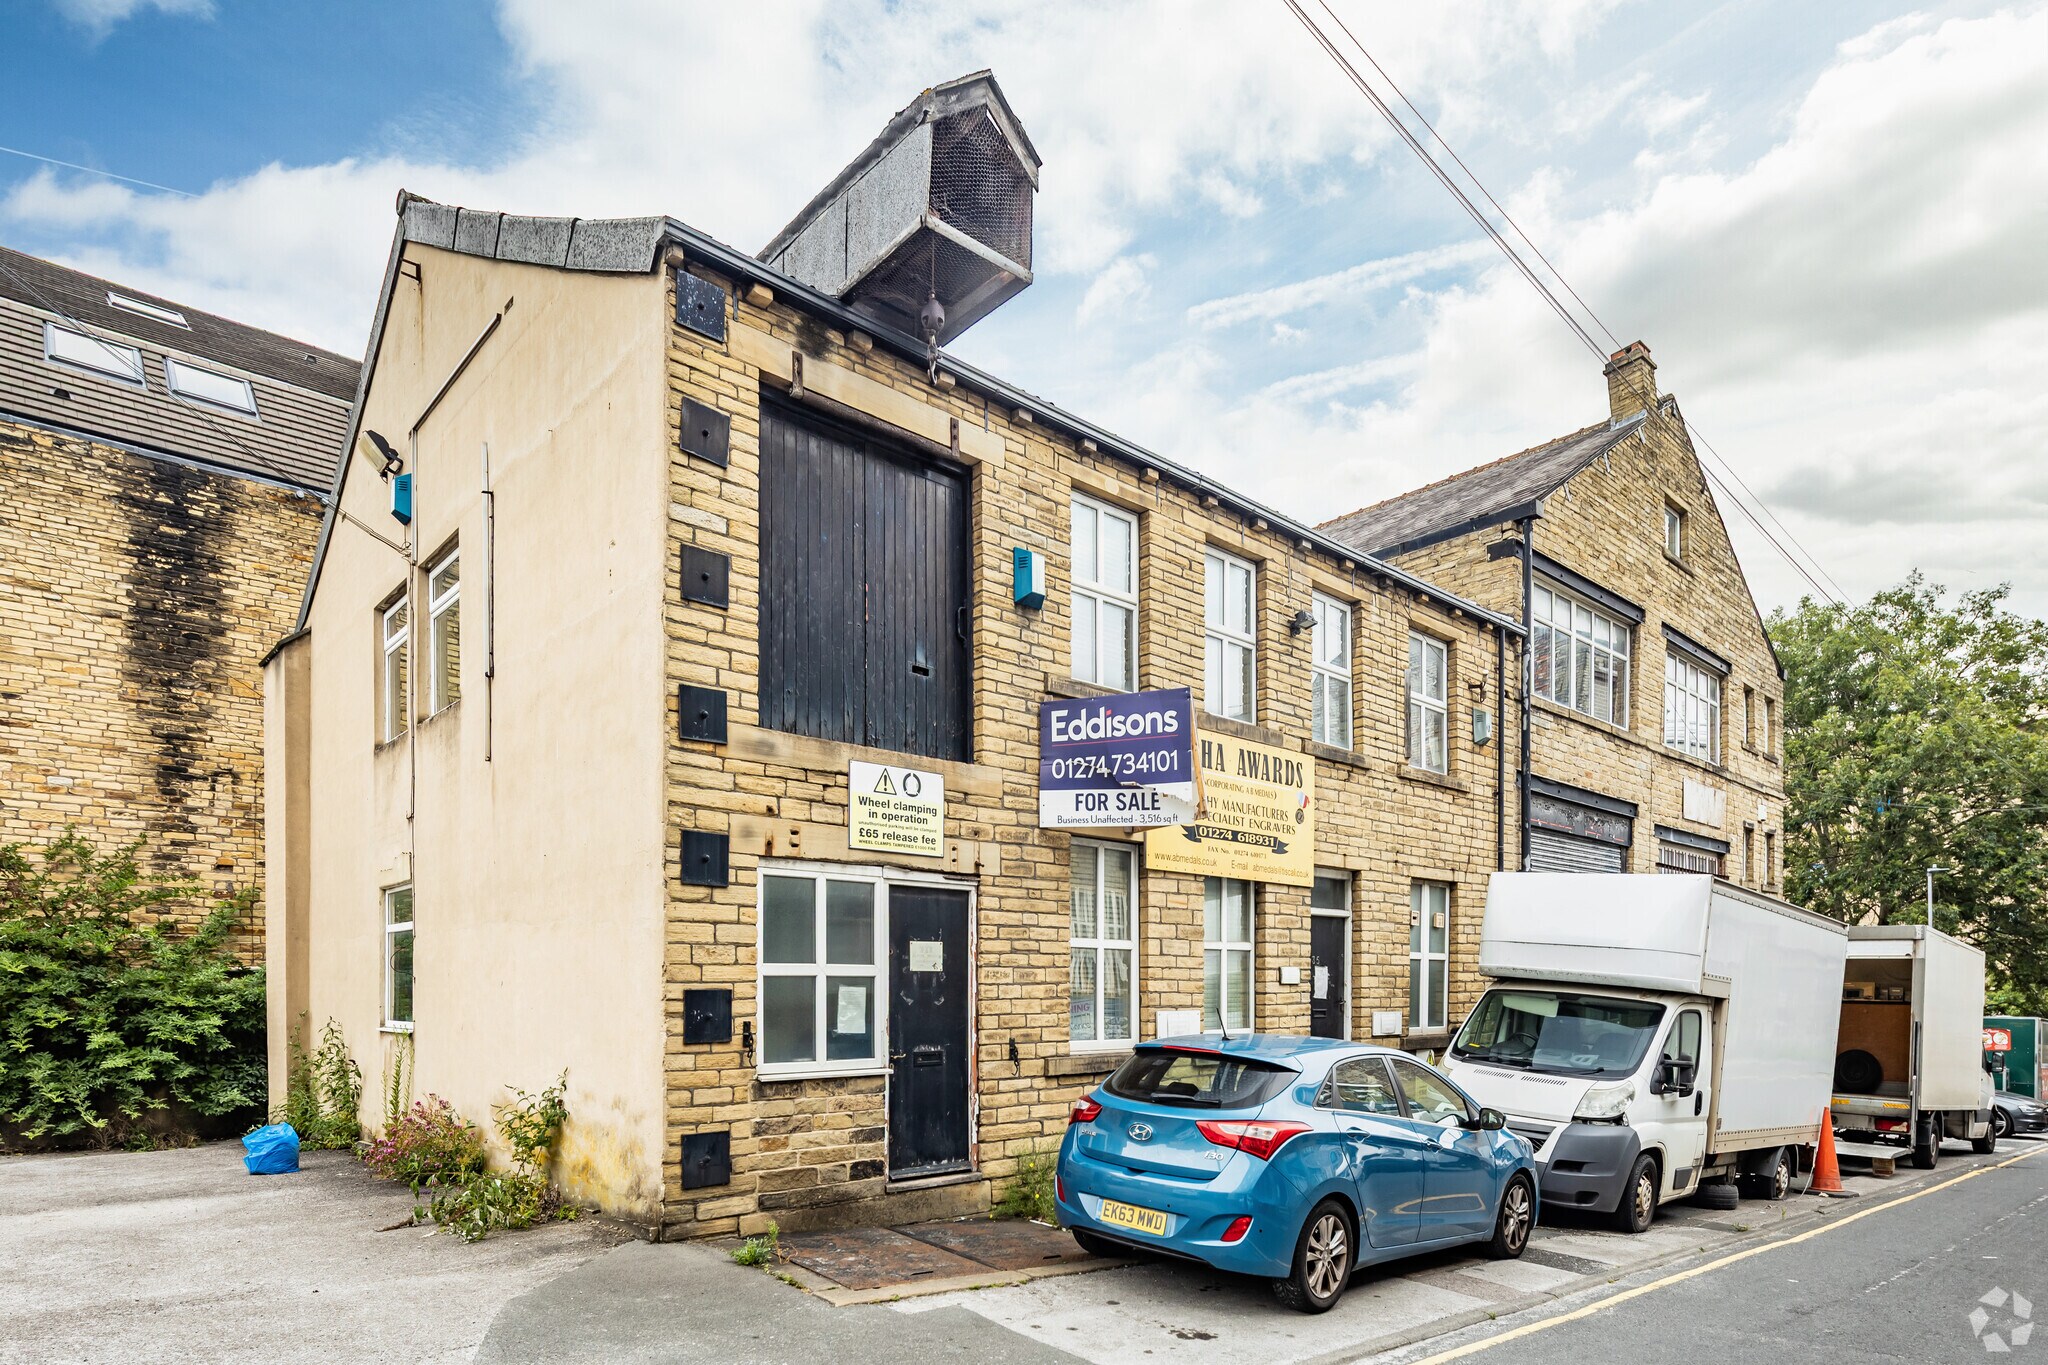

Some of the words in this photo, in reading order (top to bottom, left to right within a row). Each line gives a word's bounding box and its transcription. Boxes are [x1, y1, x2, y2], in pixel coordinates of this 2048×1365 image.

[1051, 706, 1178, 742] Eddisons
[1052, 756, 1109, 779] 01274
[1112, 750, 1178, 775] 734101
[1237, 749, 1303, 788] AWARDS
[1075, 793, 1108, 811] FOR
[1116, 792, 1161, 810] SALE
[1254, 790, 1277, 800] MEDALS)
[858, 796, 890, 809] Wheel
[894, 802, 937, 816] clamping
[1222, 798, 1288, 821] MANUFACTURERS
[869, 809, 877, 818] in
[882, 813, 928, 824] operation
[1057, 815, 1089, 824] Business
[1091, 814, 1133, 823] Unaffected
[1139, 813, 1161, 824] 3,516
[1163, 816, 1171, 825] sq
[1172, 813, 1178, 822] ft
[1208, 812, 1244, 827] ECIALIST
[1250, 819, 1296, 835] ENGRAVERS
[859, 828, 878, 838] £65
[882, 831, 918, 843] release
[922, 835, 936, 845] fee
[1199, 827, 1232, 840] 01274
[1238, 832, 1274, 847] 618931
[1155, 852, 1217, 866] www.abmedals.co.uk
[1232, 860, 1248, 870] E-mail
[1102, 1200, 1134, 1223] EK63
[1137, 1209, 1163, 1231] MWD
